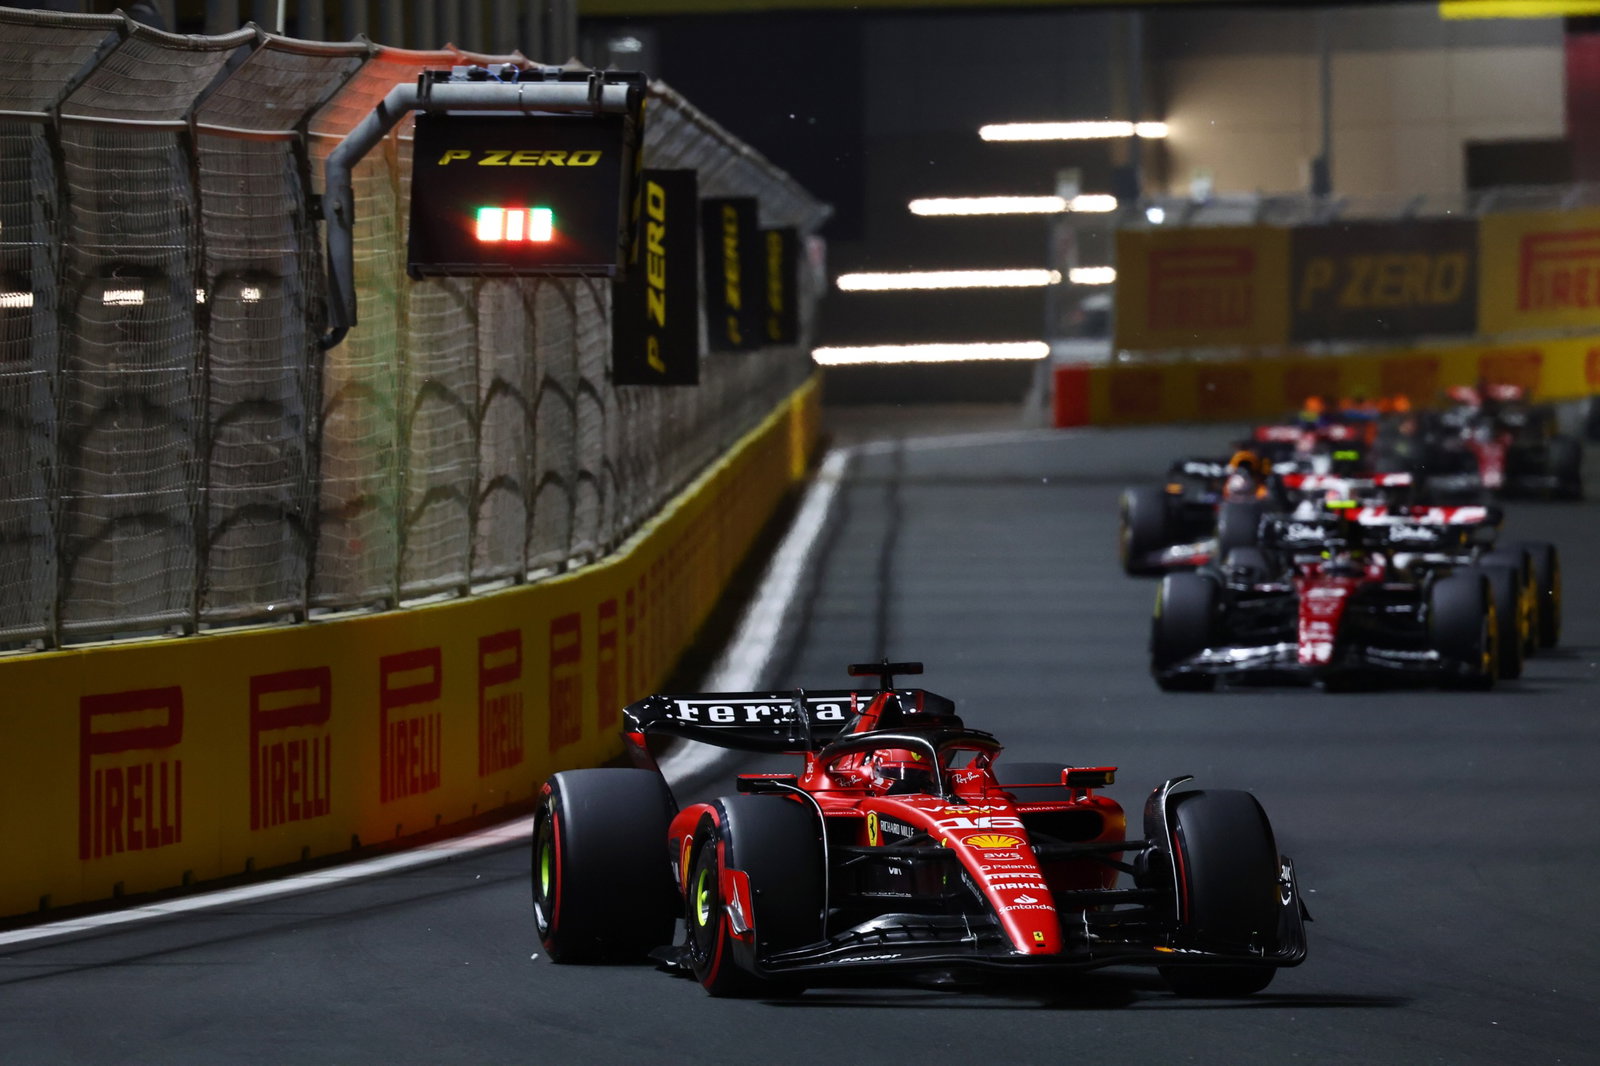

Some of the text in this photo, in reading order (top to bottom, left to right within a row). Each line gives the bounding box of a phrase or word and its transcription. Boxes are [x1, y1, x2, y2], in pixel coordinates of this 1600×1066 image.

[437, 150, 602, 166] P ZERO
[647, 180, 666, 373] P ZERO
[674, 699, 866, 723] Ferra
[379, 646, 442, 804] PIRELLI
[249, 665, 332, 831] PIRELLI
[79, 684, 184, 861] PIRELLI
[952, 772, 980, 785] Ray-Ban
[880, 820, 900, 836] RICHARD
[934, 816, 1026, 833] 16
[989, 882, 1048, 891] MAHLE
[999, 904, 1056, 914] Santander
